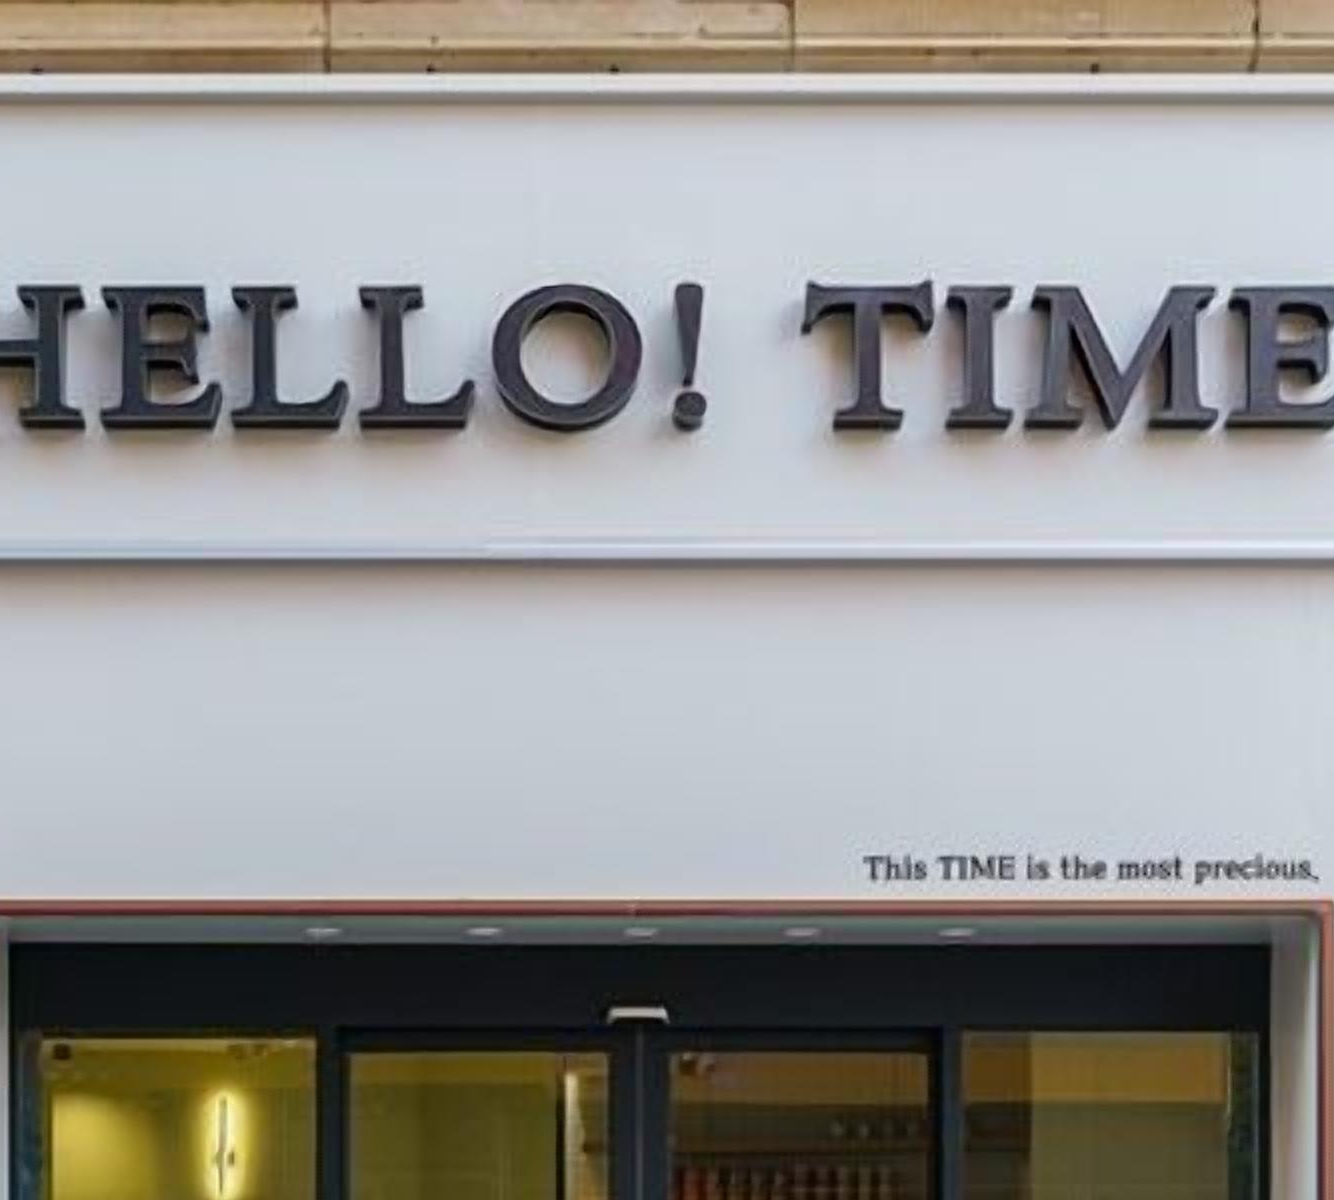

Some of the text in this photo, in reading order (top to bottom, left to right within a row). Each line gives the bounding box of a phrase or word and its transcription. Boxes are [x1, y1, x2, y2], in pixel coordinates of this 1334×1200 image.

[863, 854, 928, 881] This
[935, 854, 1016, 881] TIME
[1026, 853, 1051, 881] is
[1060, 853, 1108, 881] the
[1117, 854, 1184, 881] most
